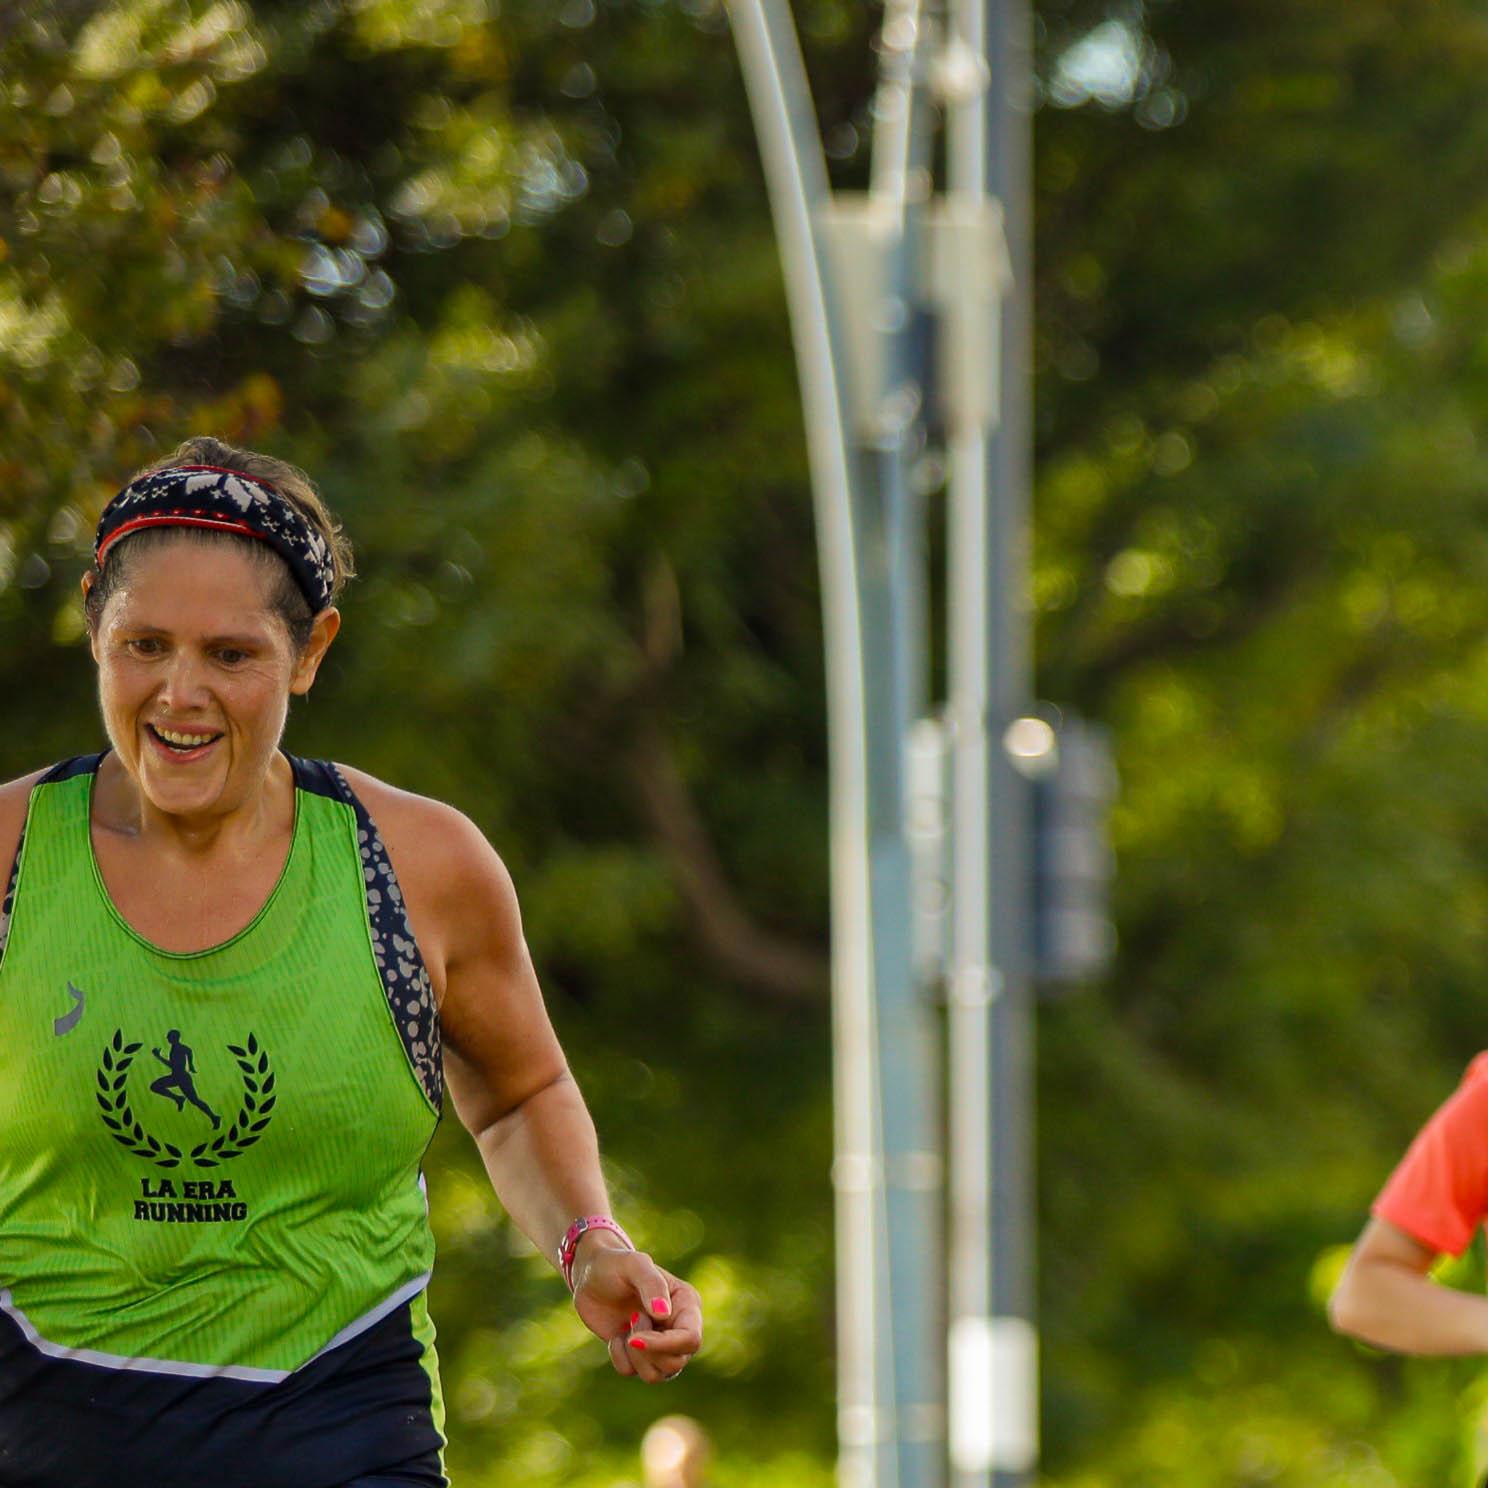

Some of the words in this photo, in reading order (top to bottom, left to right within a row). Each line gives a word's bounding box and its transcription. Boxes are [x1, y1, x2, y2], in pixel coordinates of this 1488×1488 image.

[141, 1178, 177, 1199] LA
[183, 1180, 237, 1200] ERA
[134, 1200, 248, 1223] RUNNING
